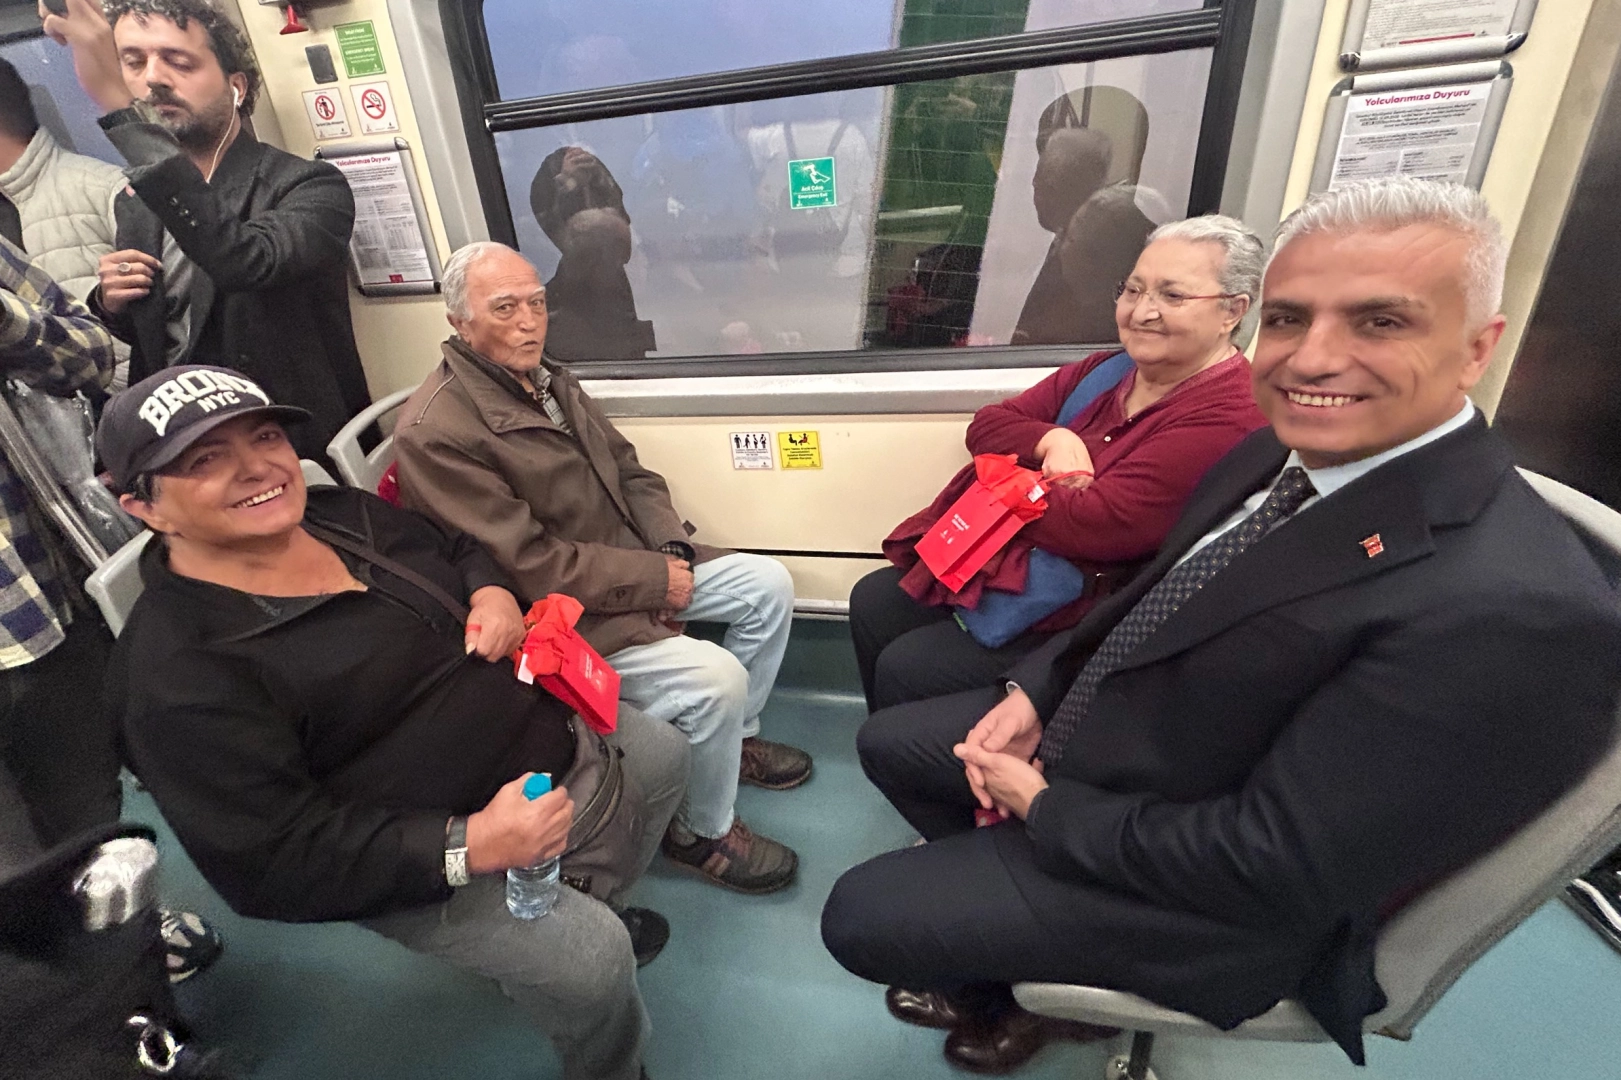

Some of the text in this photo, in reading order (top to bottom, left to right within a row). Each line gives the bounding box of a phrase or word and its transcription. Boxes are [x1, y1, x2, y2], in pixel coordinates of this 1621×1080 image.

[1365, 89, 1471, 106] Yolcularımıza Duyuru
[197, 391, 241, 413] NYC
